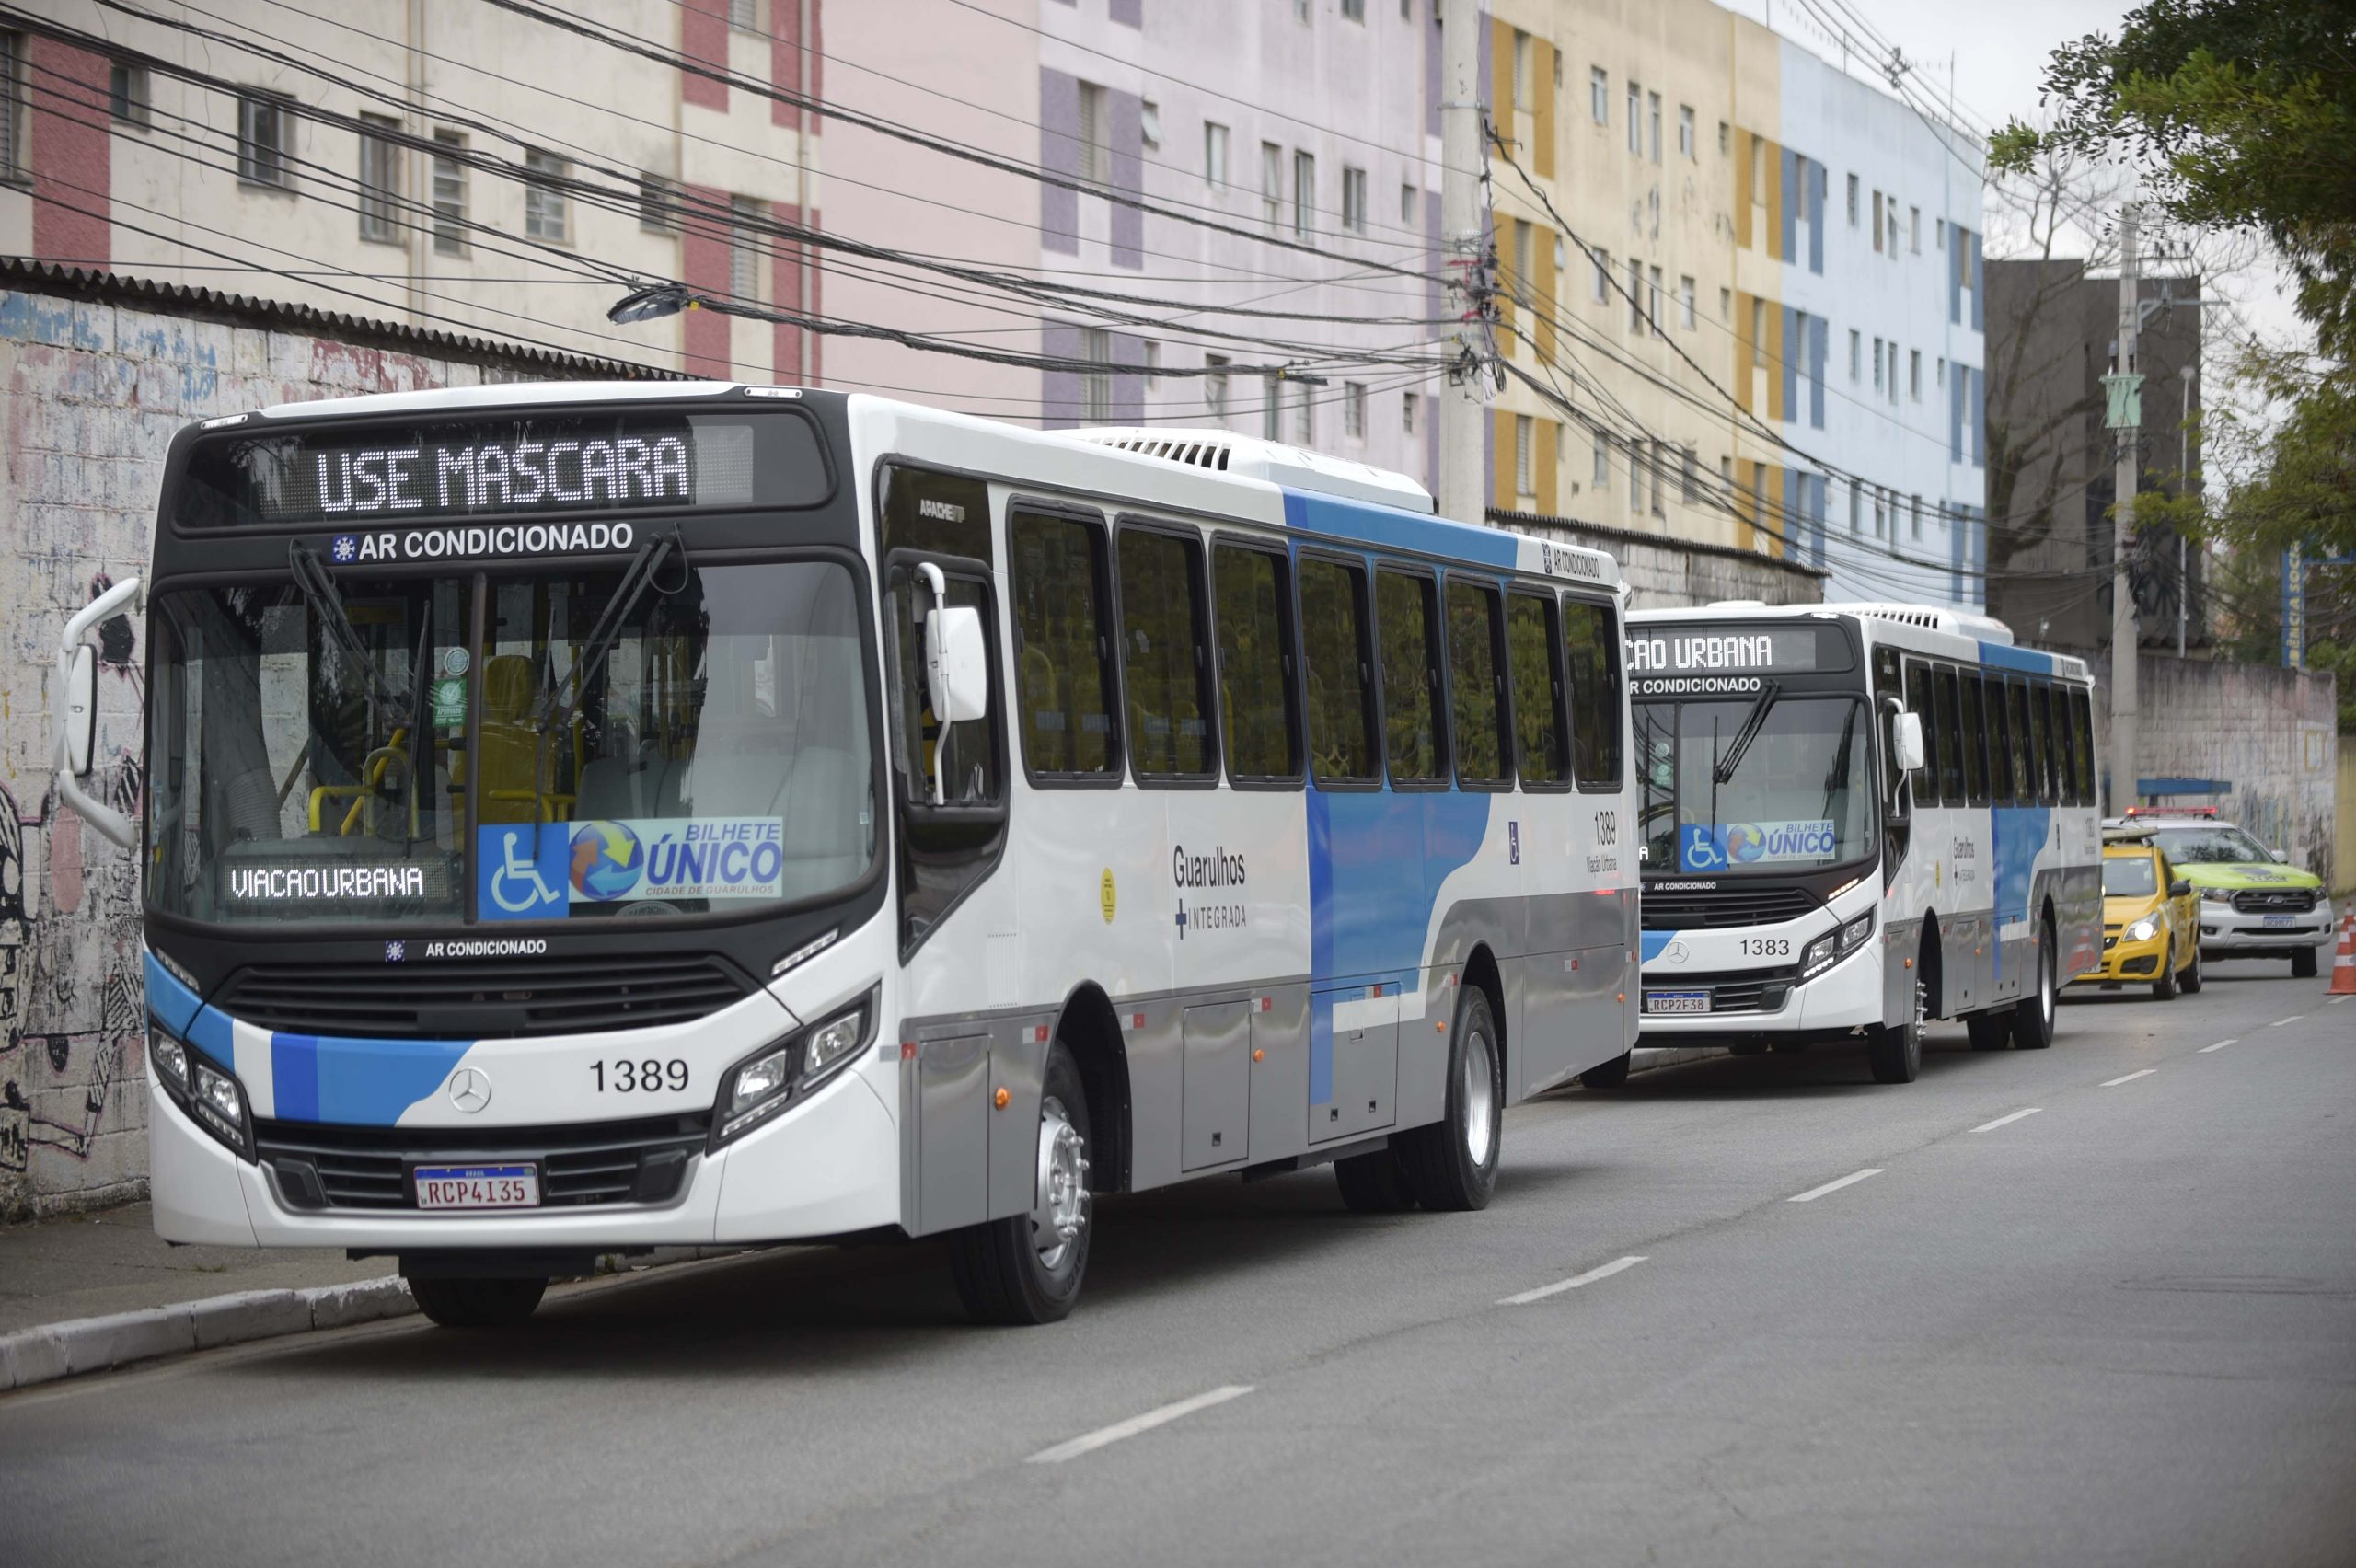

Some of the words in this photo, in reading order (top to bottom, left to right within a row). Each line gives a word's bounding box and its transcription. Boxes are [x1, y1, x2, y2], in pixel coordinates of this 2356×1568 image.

[318, 448, 422, 512] USE
[437, 437, 689, 507] MASCARA
[359, 532, 398, 560] AR
[403, 523, 633, 558] CONDICIONADO
[1674, 635, 1773, 669] URBANA
[1643, 676, 1761, 694] CONDICIONADO
[685, 824, 780, 841] BILHETE
[1595, 811, 1616, 846] 1389
[1768, 828, 1834, 855] ÚNICO
[1786, 824, 1833, 833] BILHETE
[647, 834, 781, 884] ÚNICO
[1173, 845, 1245, 888] Guarulhos
[323, 868, 422, 896] URBANA
[645, 887, 686, 895] CIDADE
[688, 886, 703, 894] DE
[706, 885, 775, 894] GUARULHOS
[1654, 882, 1664, 891] AR
[1665, 882, 1716, 890] CONDICIONADO
[1188, 905, 1246, 930] INTEGRADA
[425, 942, 444, 957] AR
[447, 940, 547, 956] CONDICIONADO
[1739, 939, 1790, 956] 1383
[1654, 999, 1703, 1010] RCP2F38
[589, 1059, 689, 1093] 1389
